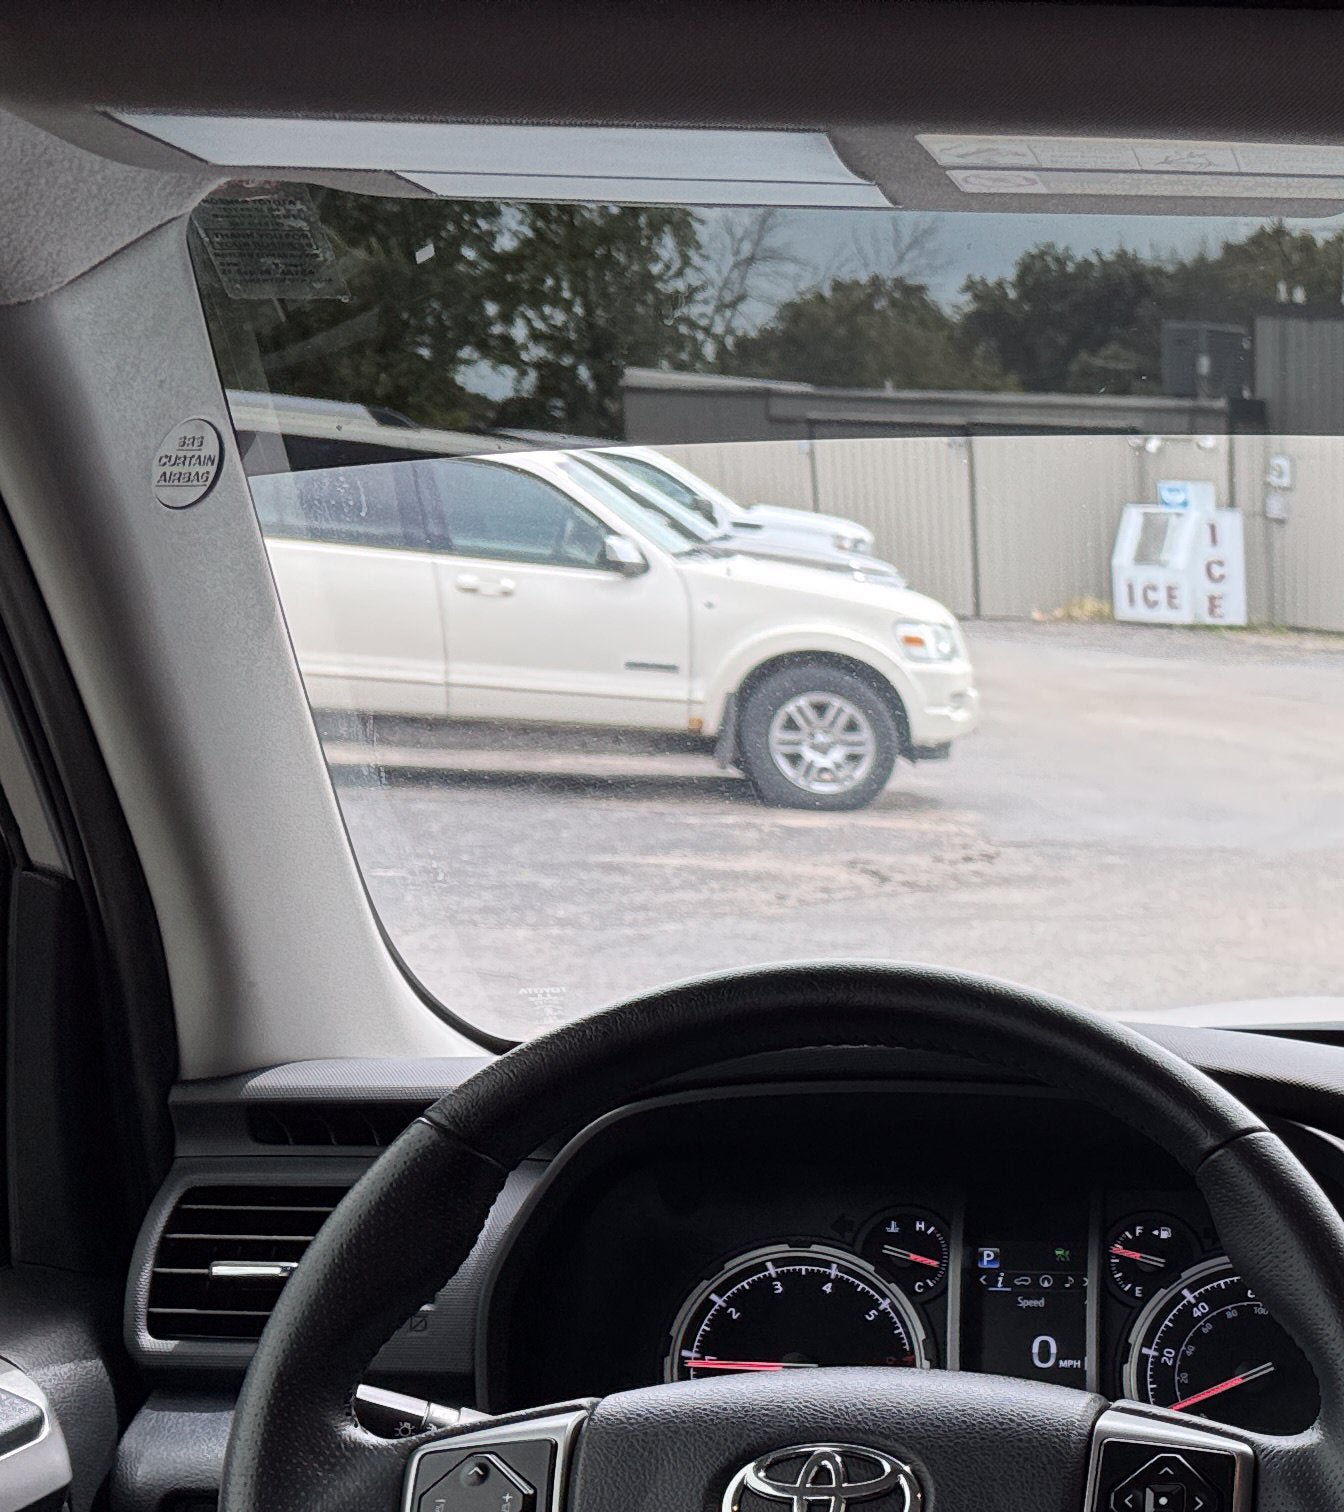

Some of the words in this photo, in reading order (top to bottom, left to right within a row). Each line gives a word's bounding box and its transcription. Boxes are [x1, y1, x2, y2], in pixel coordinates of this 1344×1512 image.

[158, 453, 217, 468] CURTAIN
[156, 470, 211, 485] AIRBAG
[1126, 581, 1183, 611] ICE
[915, 1220, 925, 1231] H
[1135, 1225, 1144, 1237] F
[983, 1250, 995, 1266] P
[771, 1281, 783, 1294] 3
[821, 1281, 833, 1294] 4
[914, 1281, 924, 1293] C
[1135, 1286, 1143, 1297] E
[1016, 1296, 1045, 1309] Speed
[726, 1307, 740, 1320] 2
[864, 1308, 879, 1321] 5
[1192, 1302, 1209, 1318] 40
[1031, 1335, 1057, 1368] 0
[1058, 1359, 1081, 1369] MPH
[1161, 1347, 1176, 1366] 20
